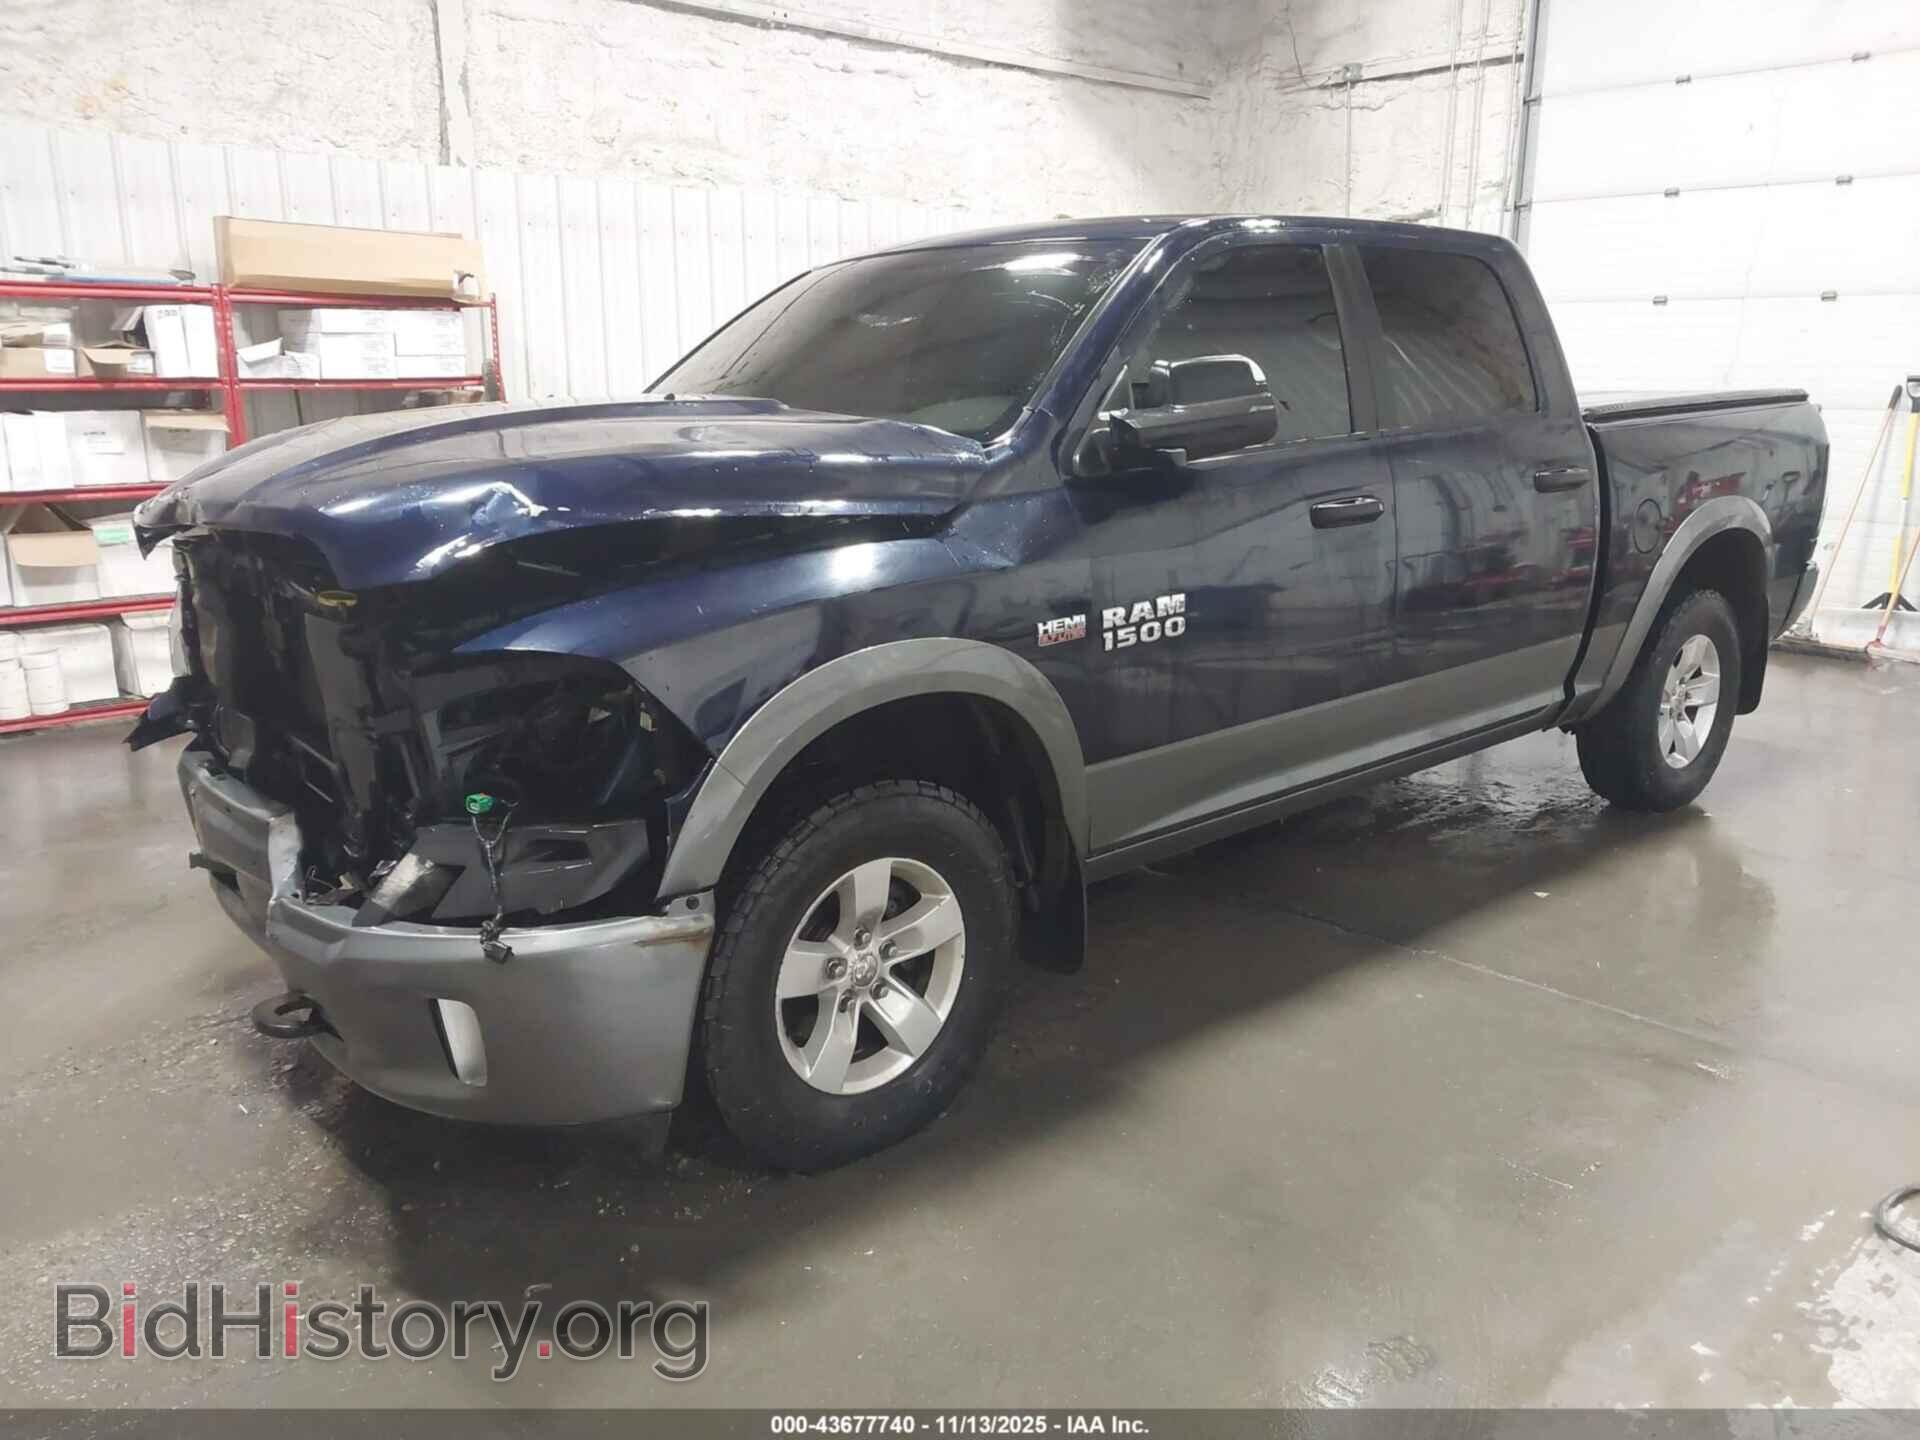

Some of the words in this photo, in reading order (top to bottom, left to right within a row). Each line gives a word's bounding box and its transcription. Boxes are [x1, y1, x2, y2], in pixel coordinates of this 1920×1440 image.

[1037, 613, 1086, 636] HEMI
[1102, 593, 1186, 629] RAM
[1103, 616, 1186, 651] 1500
